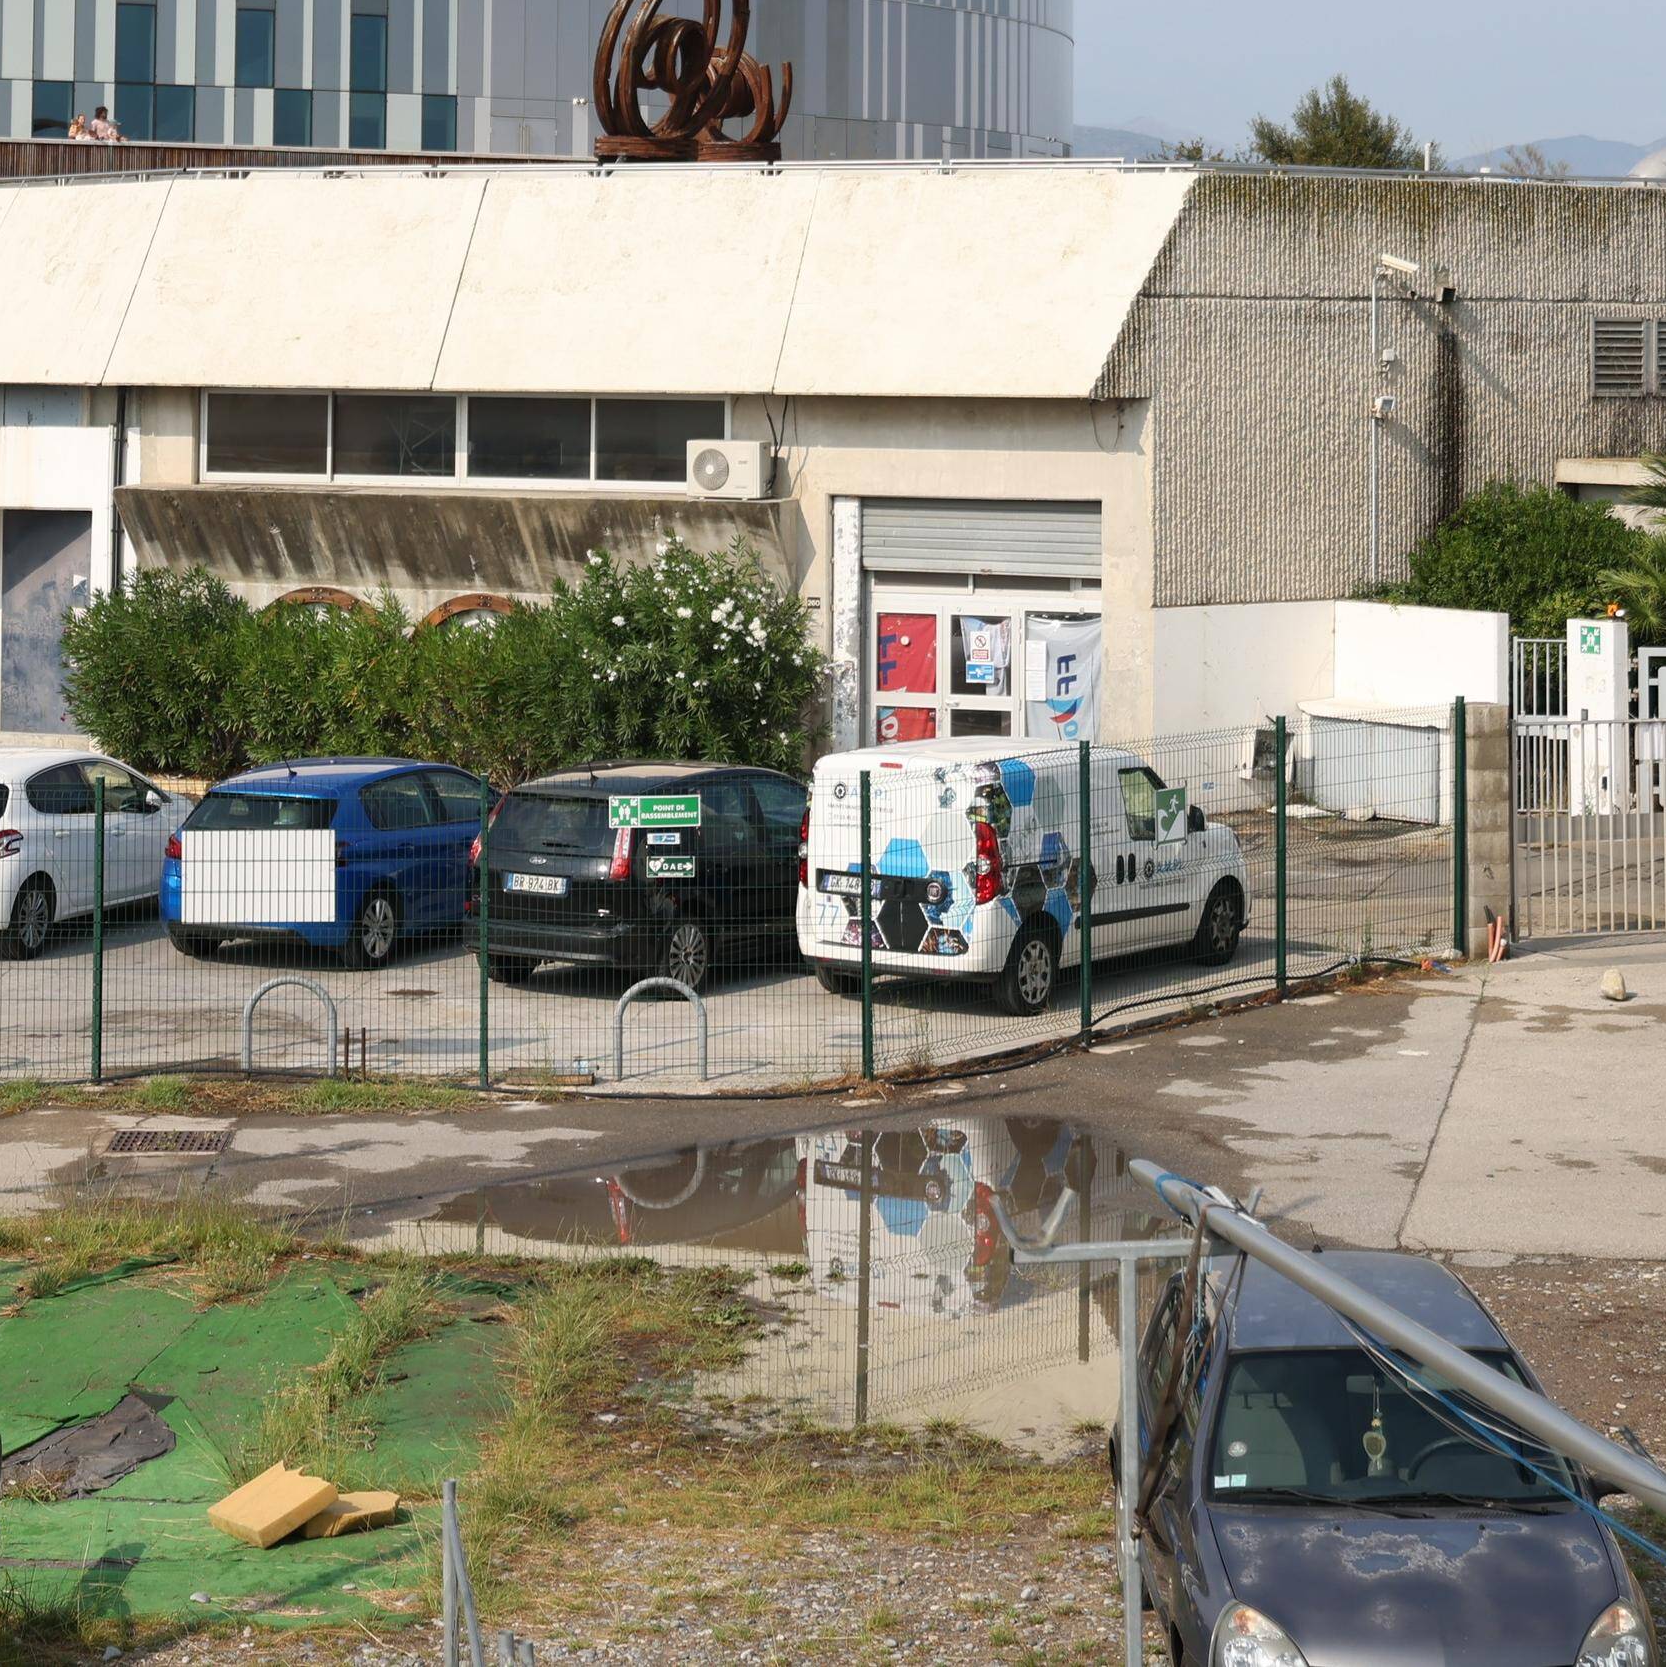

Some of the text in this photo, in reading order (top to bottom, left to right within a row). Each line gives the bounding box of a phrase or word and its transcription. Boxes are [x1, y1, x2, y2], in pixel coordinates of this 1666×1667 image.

[653, 804, 674, 812] POINT
[640, 811, 697, 820] RASSEMBLEMENT
[816, 902, 840, 926] 77
